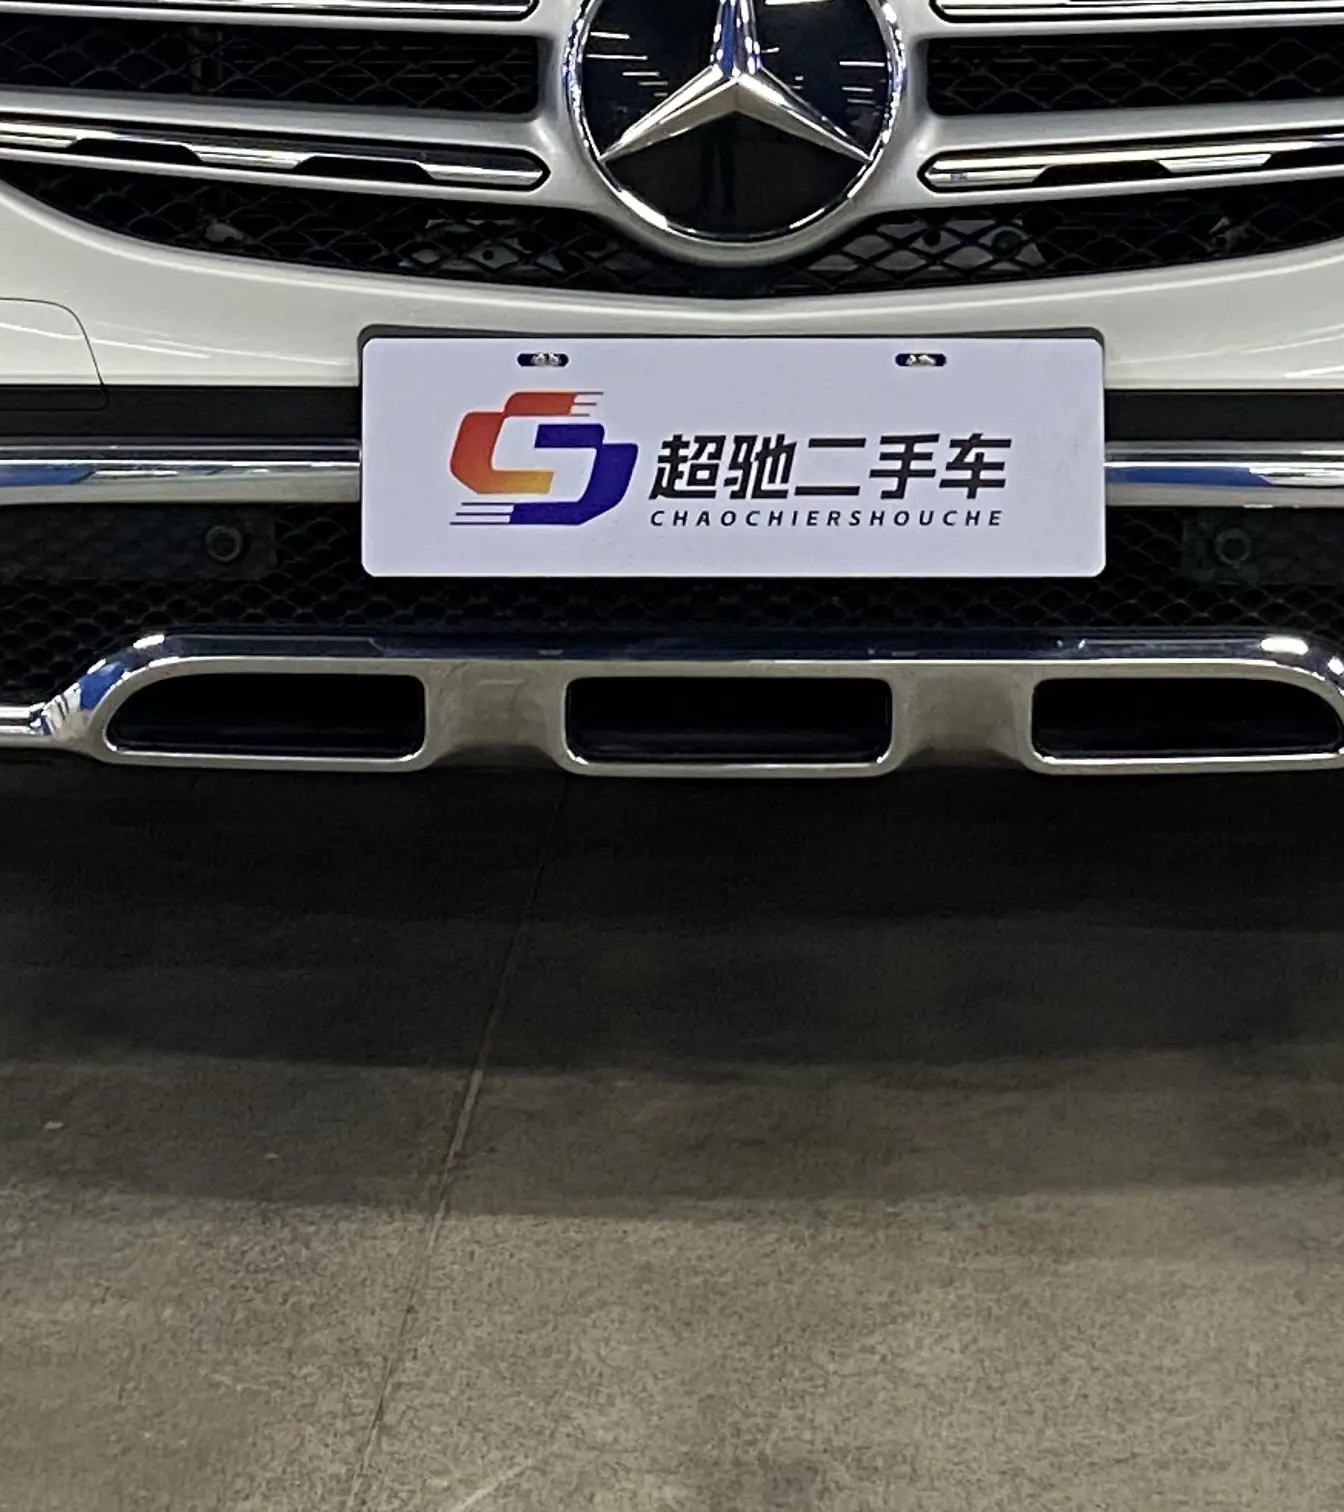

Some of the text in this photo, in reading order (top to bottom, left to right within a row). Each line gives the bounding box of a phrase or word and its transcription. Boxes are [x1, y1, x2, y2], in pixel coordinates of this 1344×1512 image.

[648, 432, 1013, 501] 超驰二手车
[650, 509, 1003, 527] CHAOCHIERSHOUCHE
